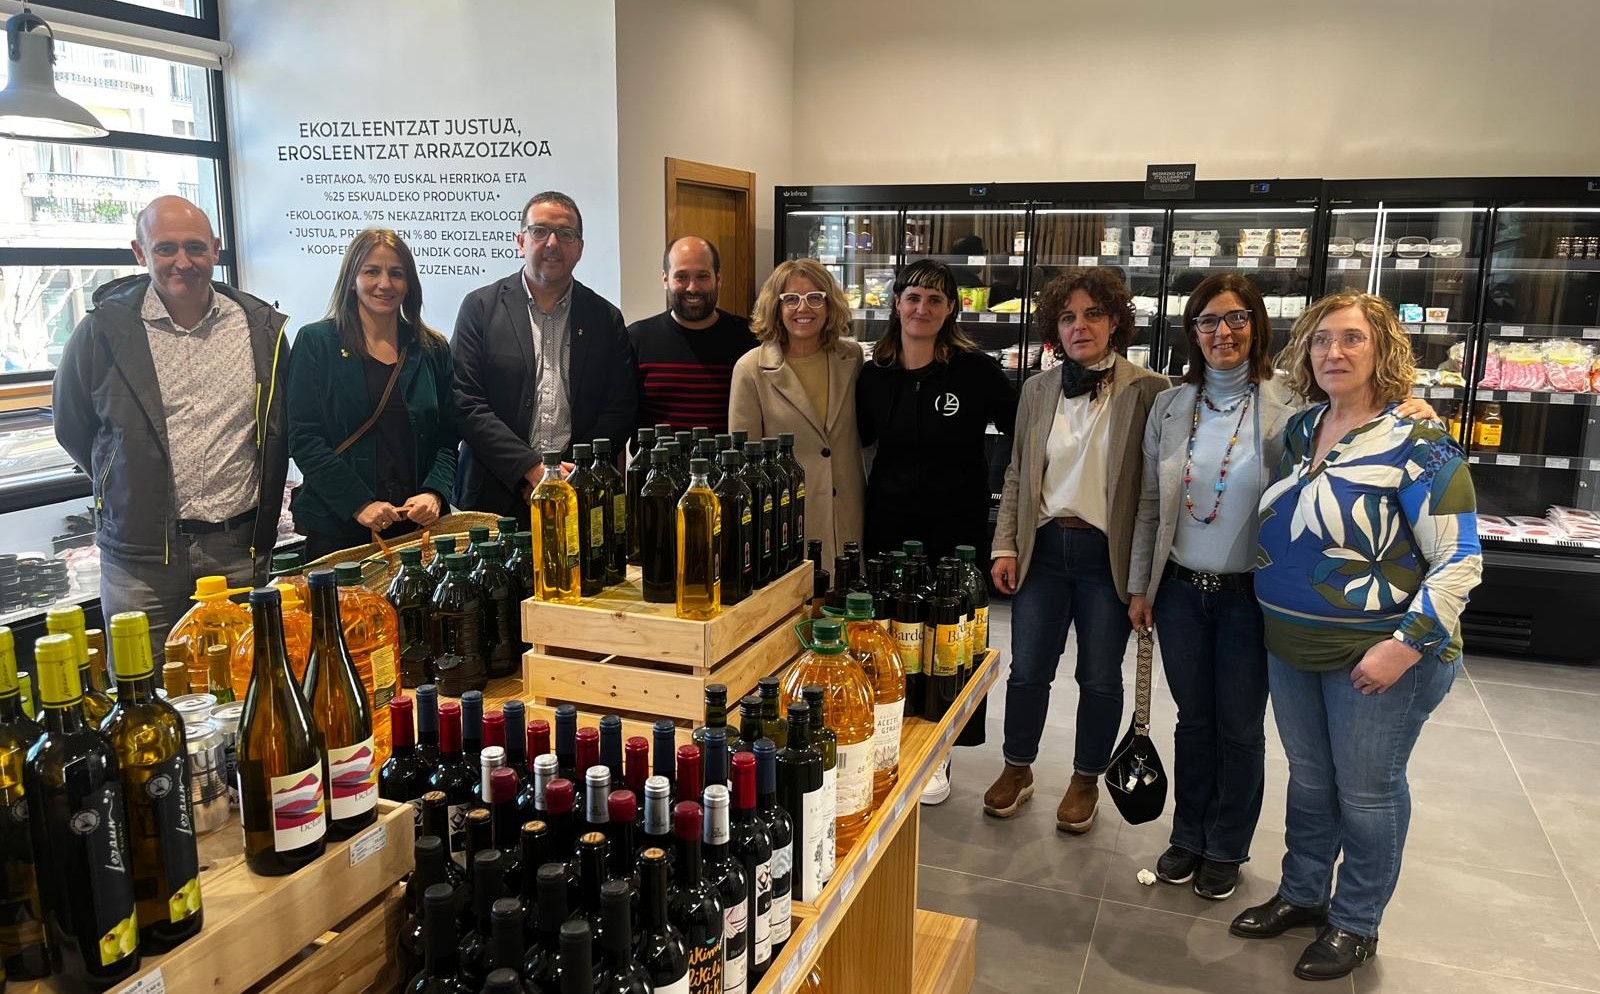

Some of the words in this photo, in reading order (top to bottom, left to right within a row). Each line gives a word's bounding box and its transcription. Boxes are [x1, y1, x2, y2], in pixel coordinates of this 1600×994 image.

[299, 119, 440, 138] EKOIZLEENTZAT
[445, 117, 521, 137] JUSTUA,
[278, 143, 409, 161] EROSLEENTZAT
[414, 140, 552, 159] ARRAZOIZKOA
[368, 173, 390, 184] %70
[394, 173, 437, 184] EUSKAL
[440, 173, 501, 184] HERRIKOA
[505, 172, 527, 183] ETA
[324, 191, 345, 202] %25
[348, 191, 420, 202] ESKUALDEKO
[363, 210, 385, 221] %75
[388, 211, 467, 221] NEKAZARITZA
[470, 210, 522, 221] EKOLOGI
[397, 230, 411, 240] EN
[441, 230, 518, 241] EKOIZLEAREN
[410, 247, 451, 258] UNDIK
[453, 247, 487, 258] GORA
[419, 264, 480, 276] ZUZENEAN
